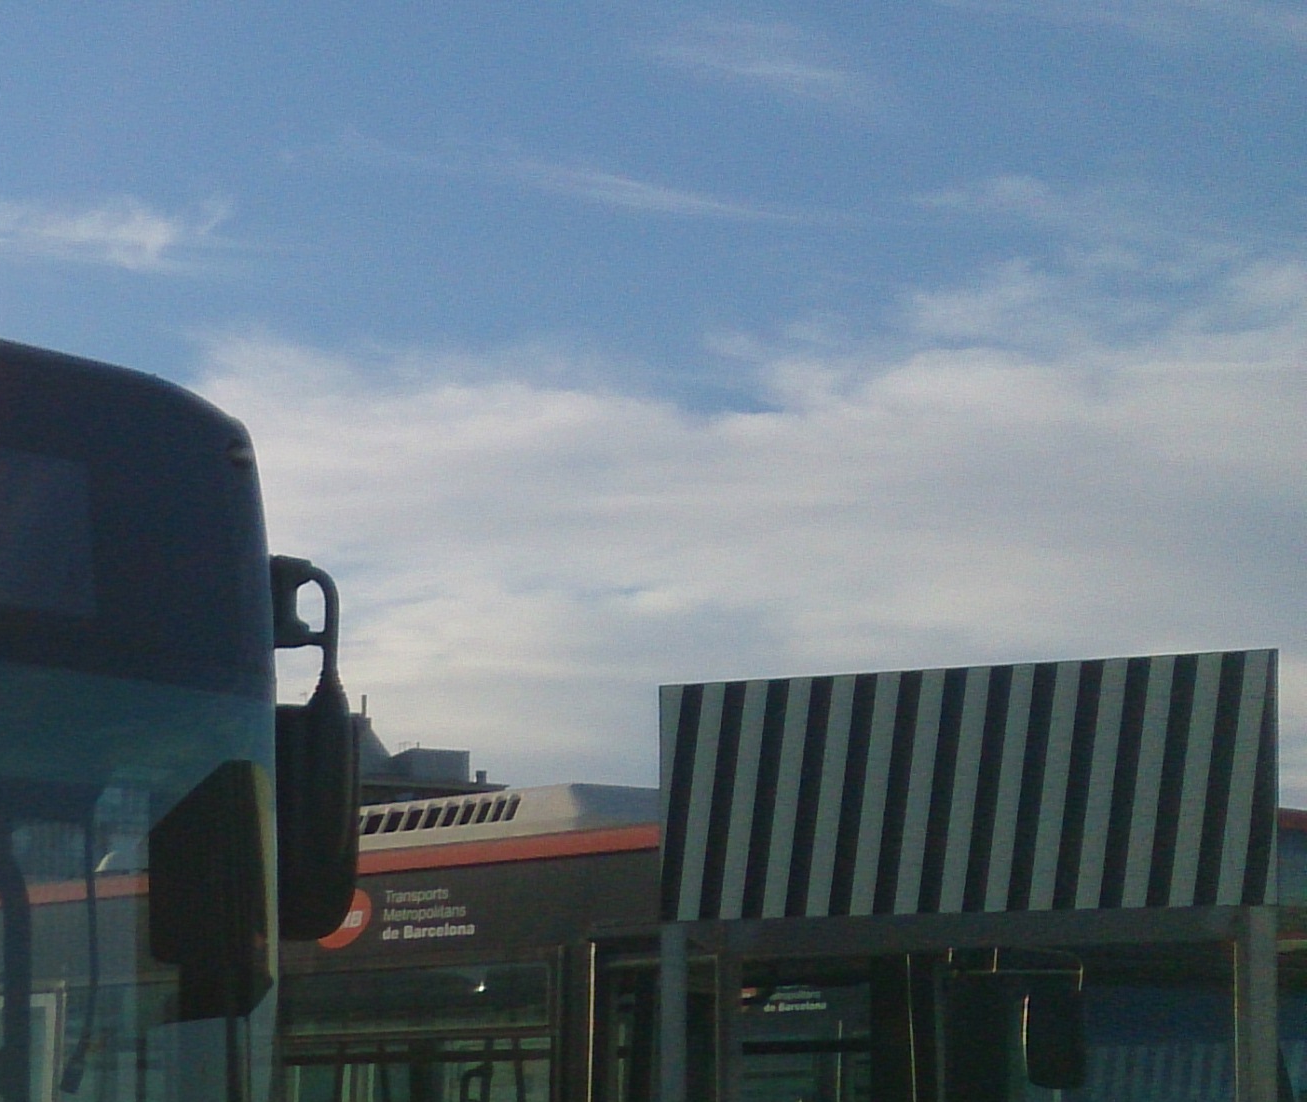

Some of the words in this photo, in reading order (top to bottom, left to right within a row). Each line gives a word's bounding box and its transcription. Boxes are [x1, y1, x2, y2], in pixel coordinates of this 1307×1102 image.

[386, 887, 449, 904] Transports
[383, 904, 467, 923] Metropolitans
[382, 924, 399, 941] de
[403, 922, 476, 940] Barcelona
